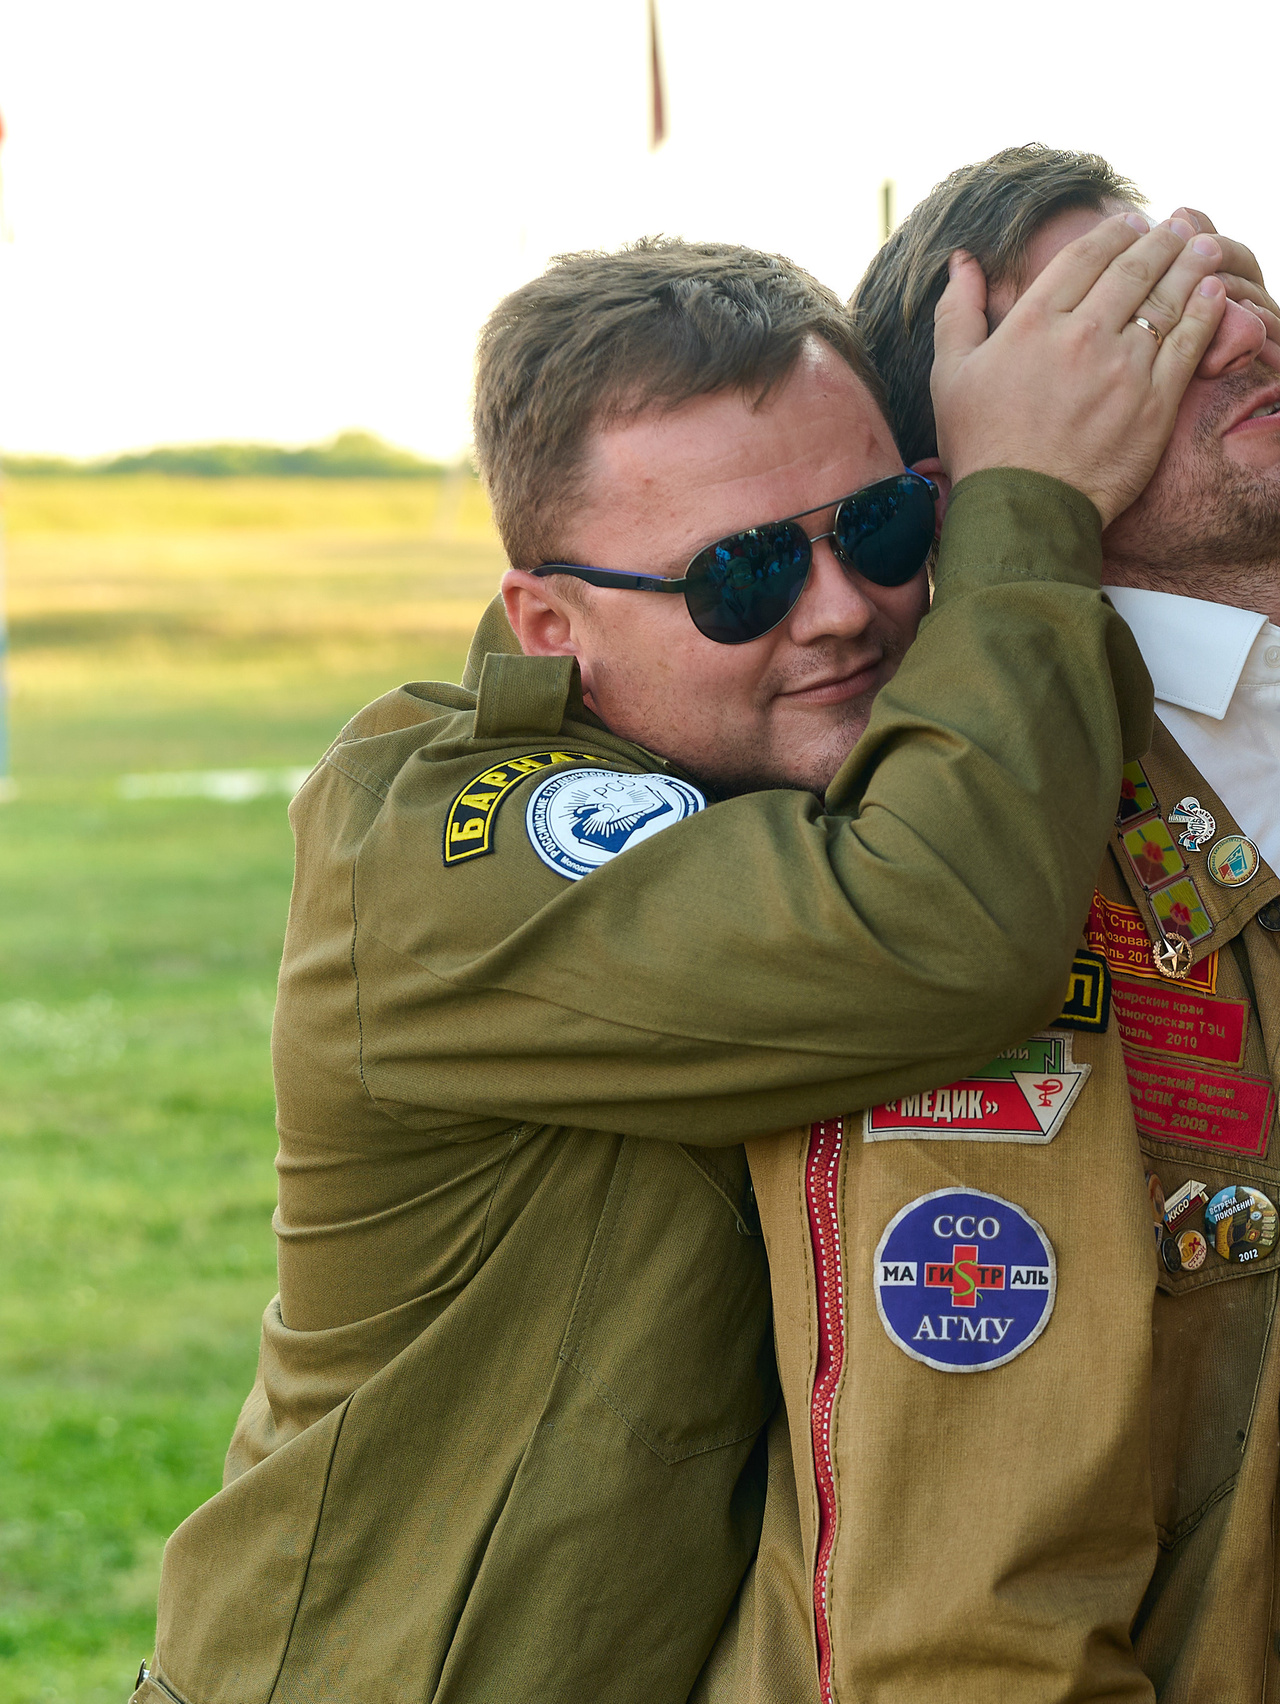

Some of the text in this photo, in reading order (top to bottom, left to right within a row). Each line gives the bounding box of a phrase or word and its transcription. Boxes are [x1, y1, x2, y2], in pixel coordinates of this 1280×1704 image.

[593, 780, 636, 799] РСО
[534, 797, 561, 859] РОССИЙСКИЕ
[1128, 949, 1152, 965] 201
[1199, 1021, 1225, 1038] ТЭЦ
[1165, 1032, 1198, 1049] 2010
[1144, 1088, 1175, 1107] СПК
[1178, 1097, 1249, 1121] «Восток»
[1170, 1113, 1208, 1132] 2009
[1167, 1198, 1190, 1223] ККСО
[1208, 1196, 1238, 1215] ВСТРЕЧА
[1214, 1195, 1255, 1222] ПОКОЛЕНИЙ
[933, 1215, 1001, 1240] ССО
[1238, 1248, 1259, 1263] 2012
[883, 1266, 915, 1281] МА
[1011, 1270, 1049, 1285] АЛЬ
[912, 1315, 1014, 1344] АГМУ
